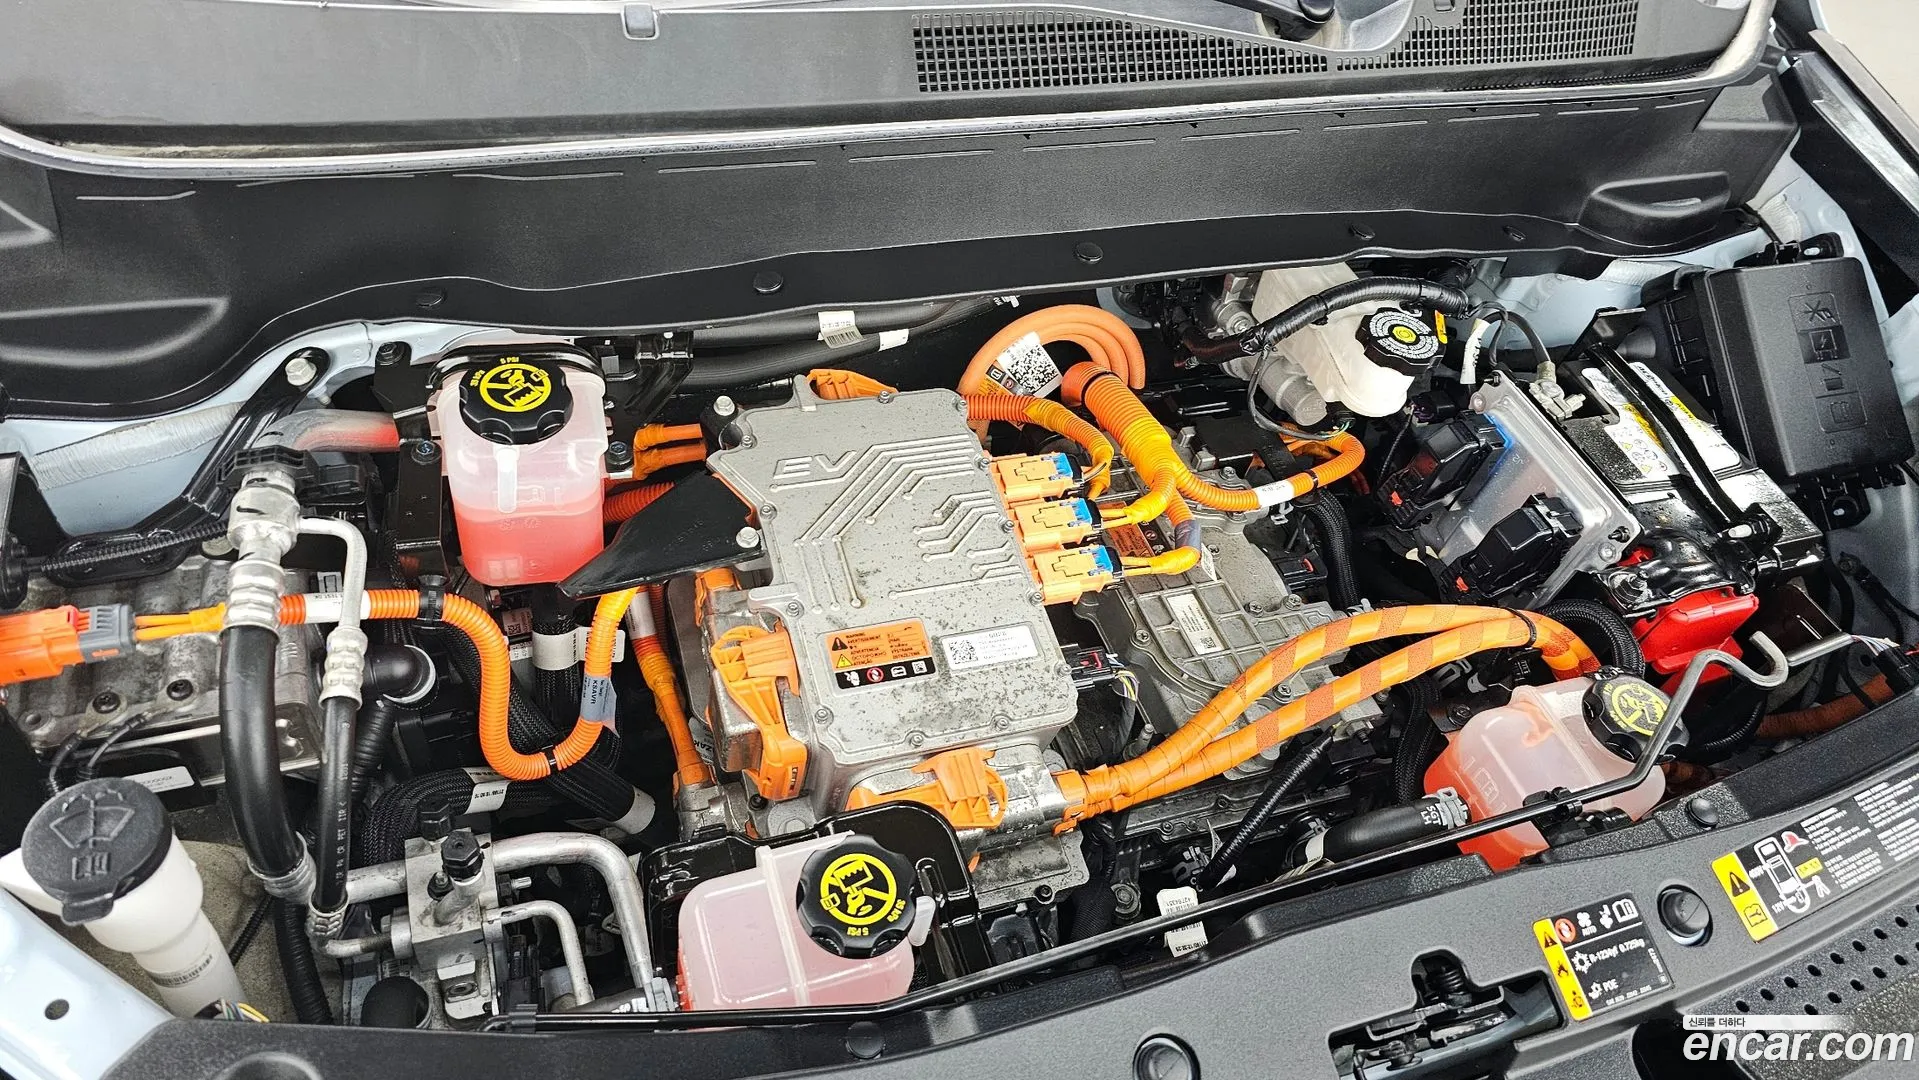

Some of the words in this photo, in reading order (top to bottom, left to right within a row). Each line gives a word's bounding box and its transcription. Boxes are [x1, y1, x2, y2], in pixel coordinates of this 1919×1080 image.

[773, 450, 857, 480] EV
[1420, 810, 1432, 825] LH
[1426, 805, 1442, 825] SGT
[847, 926, 862, 937] PSI
[862, 926, 869, 936] 5
[1581, 925, 1597, 937] AUTO
[1588, 945, 1619, 964] R-1234yf
[1602, 978, 1619, 993] POE
